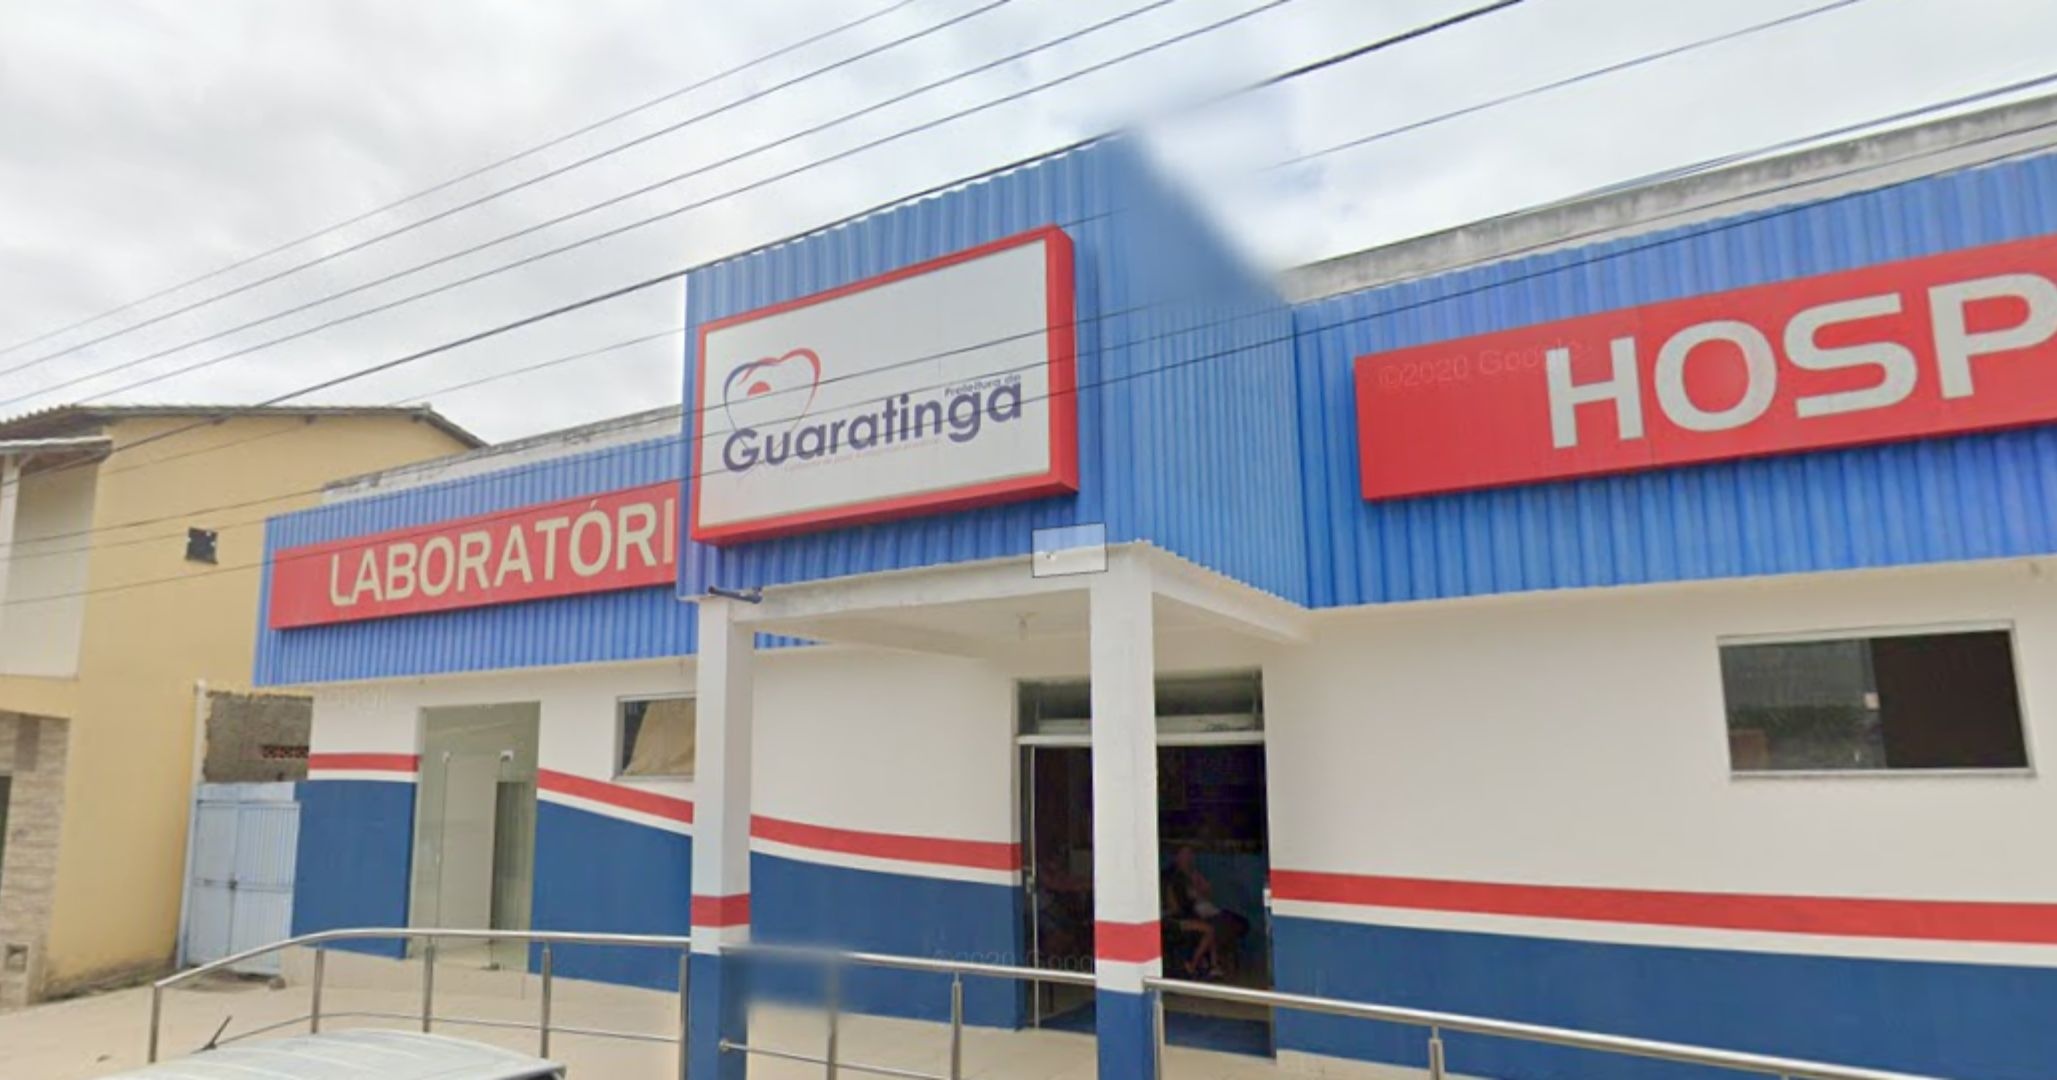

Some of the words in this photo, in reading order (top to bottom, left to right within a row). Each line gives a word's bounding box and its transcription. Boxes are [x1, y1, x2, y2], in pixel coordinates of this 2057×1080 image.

[1545, 272, 2057, 449] HOSP
[723, 381, 1022, 472] Guaratinga
[330, 498, 676, 608] LABORATÓRI
